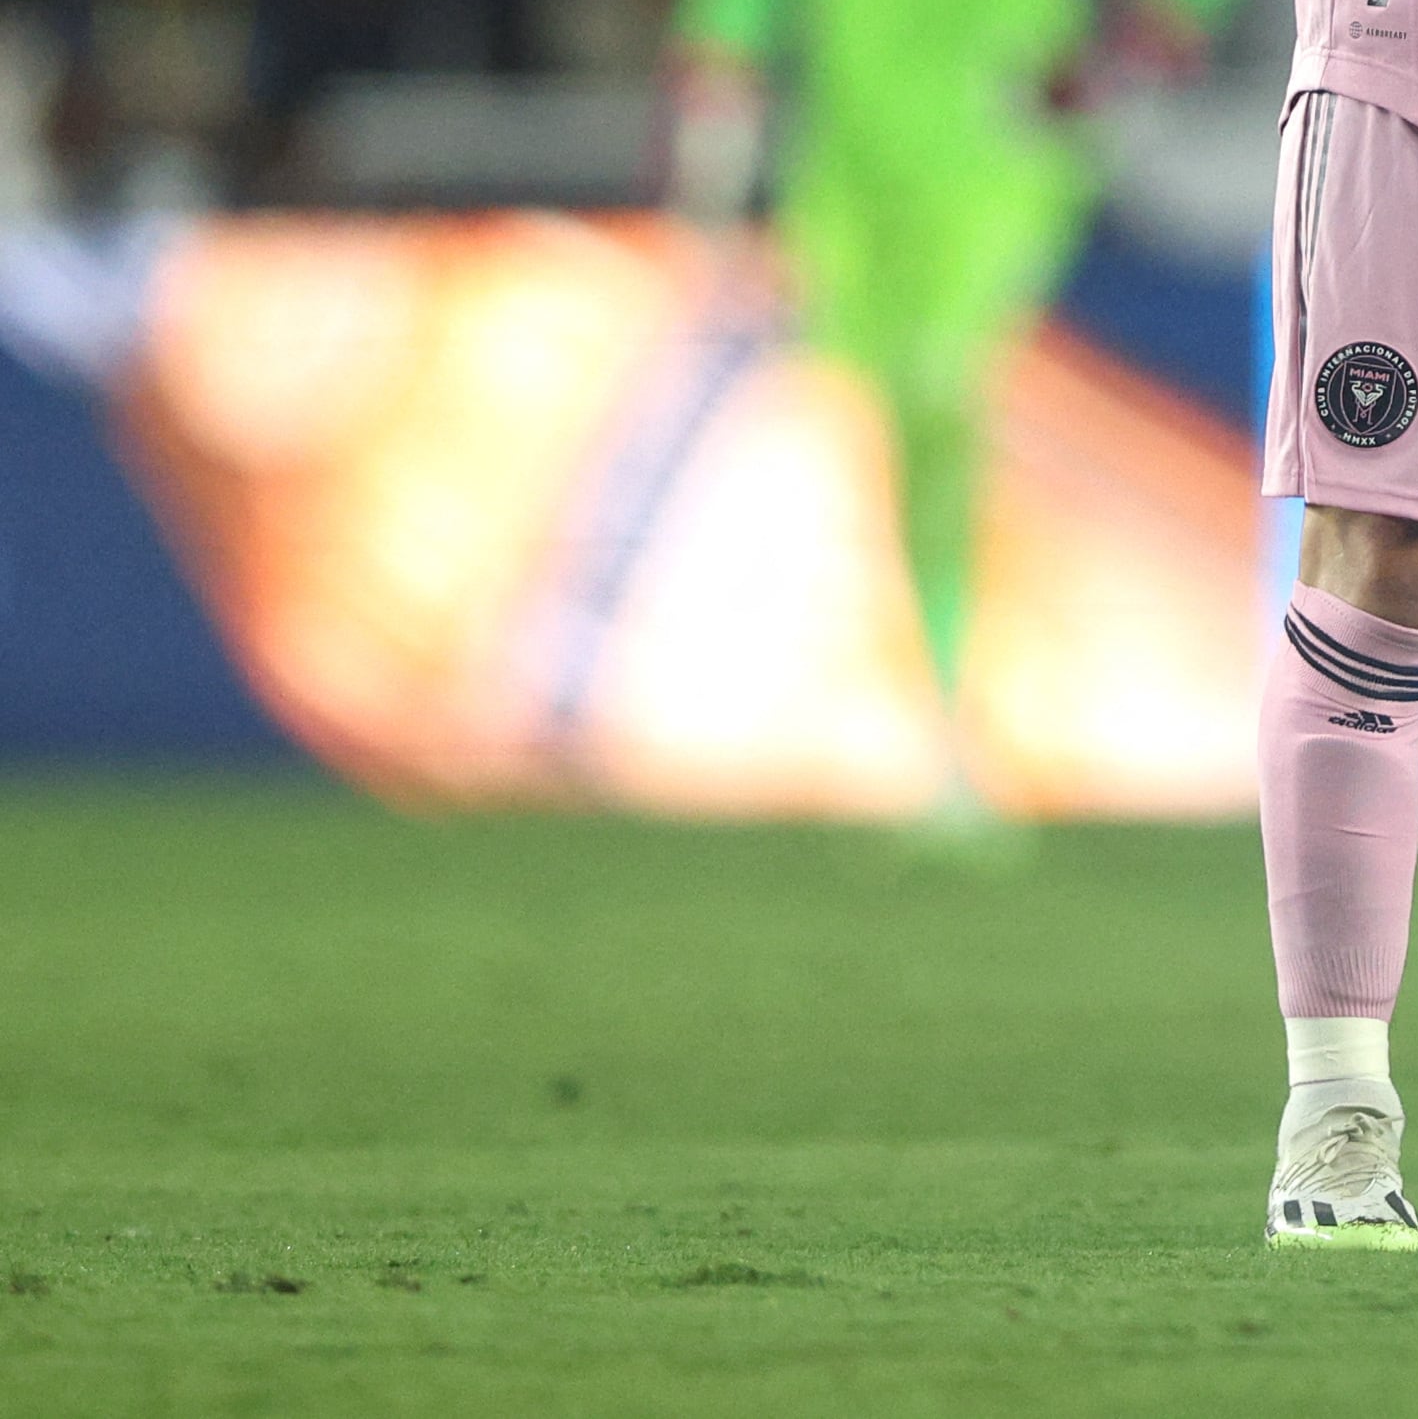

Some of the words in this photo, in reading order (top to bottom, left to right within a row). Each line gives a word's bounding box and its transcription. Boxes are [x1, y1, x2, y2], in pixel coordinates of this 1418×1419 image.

[1320, 345, 1405, 382] INTERNACIONAL
[1349, 368, 1391, 382] MIAMI
[1403, 370, 1415, 386] DE
[1317, 387, 1329, 417] CLUB
[1342, 432, 1377, 446] MMXX
